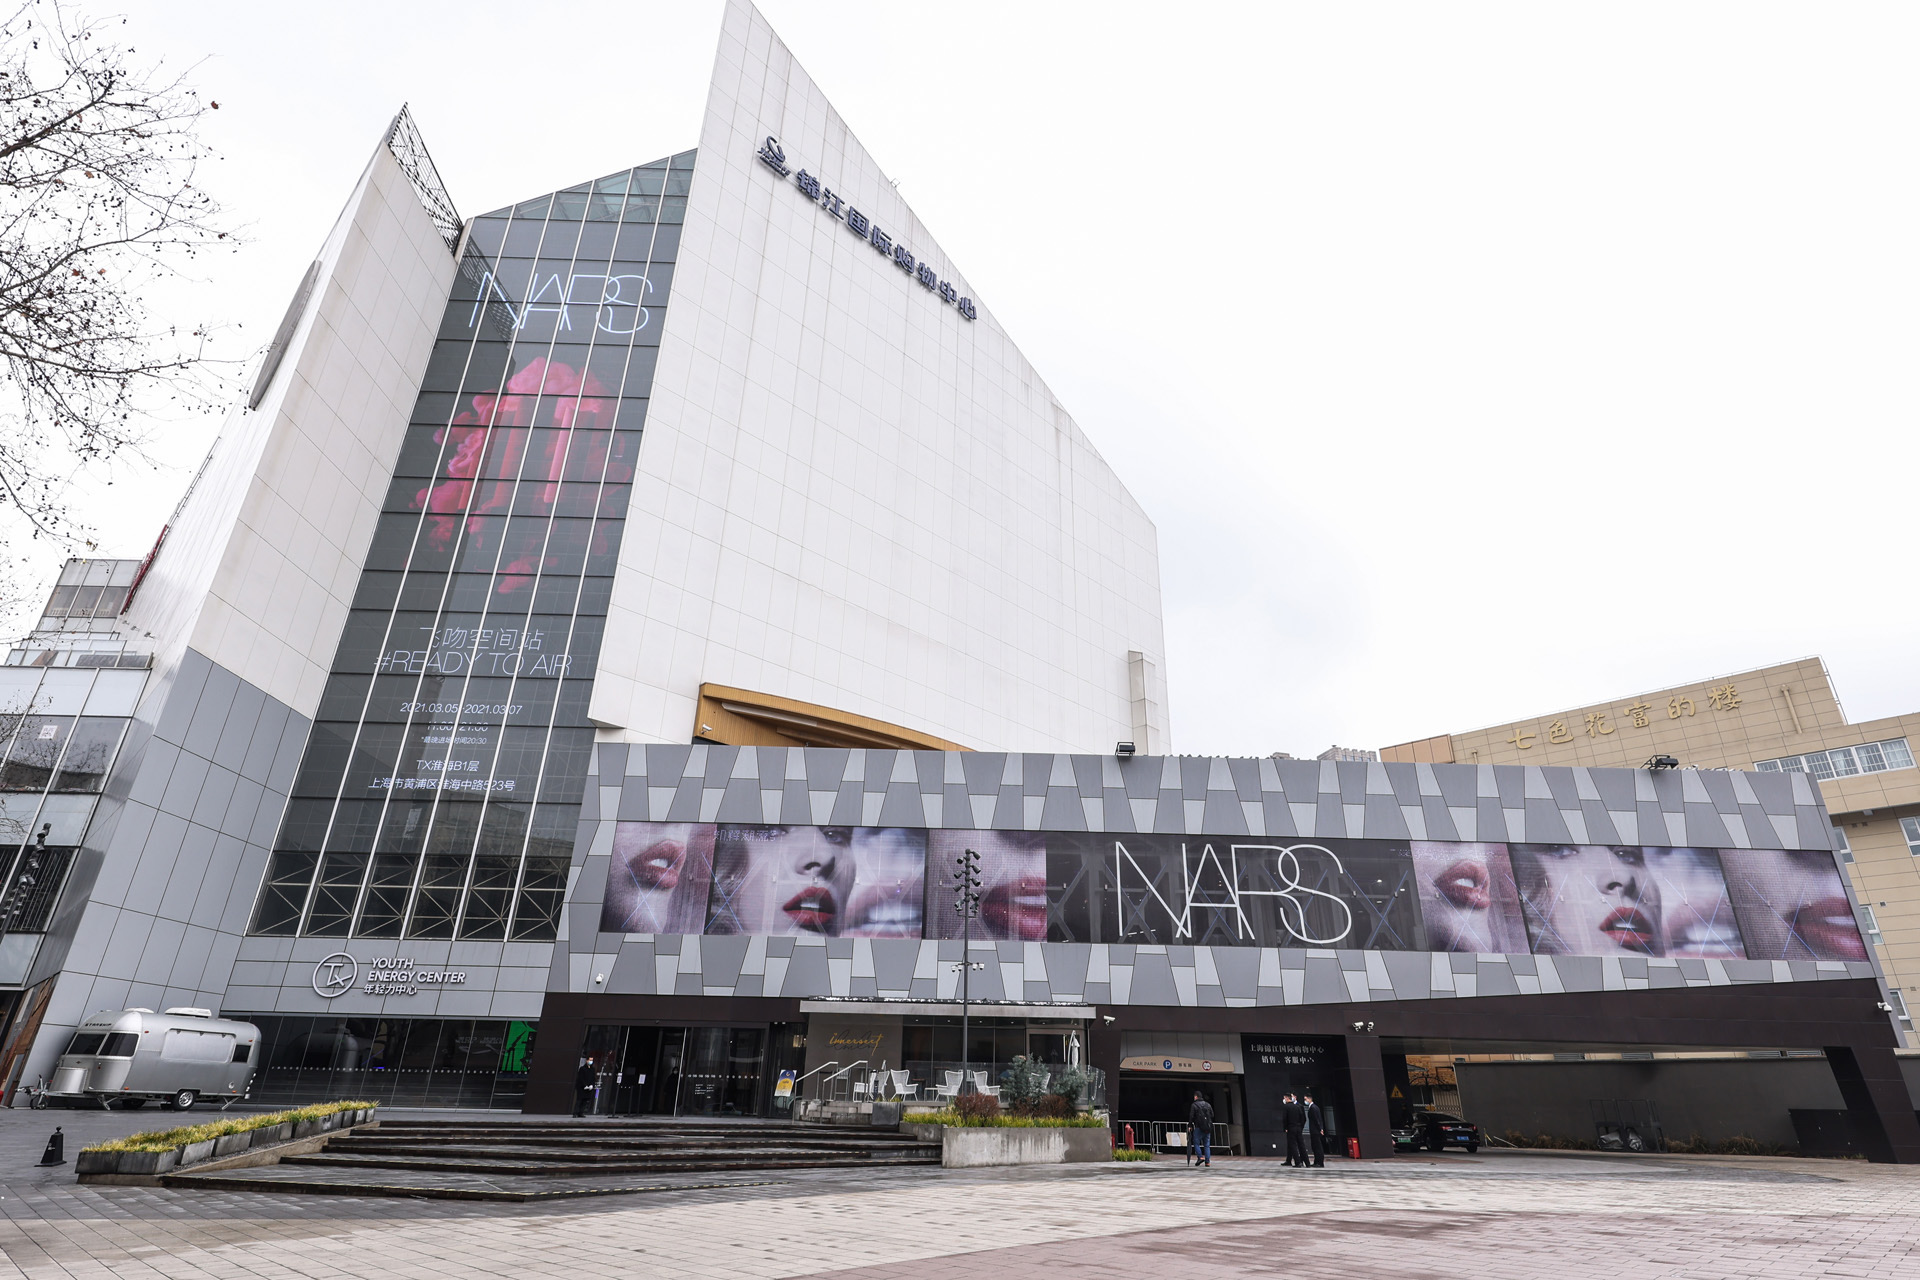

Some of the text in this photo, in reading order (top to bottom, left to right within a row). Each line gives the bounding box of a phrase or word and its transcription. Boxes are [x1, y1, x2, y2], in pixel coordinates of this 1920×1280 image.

[796, 168, 977, 320] 锦江国际购物中心
[469, 271, 653, 334] NARS
[374, 650, 573, 676] #READY TO AIR
[1116, 841, 1352, 944] NARS
[371, 958, 415, 969] YOUTH
[363, 984, 417, 996] 年轻力中心
[367, 971, 466, 984] ENERGY CENTER
